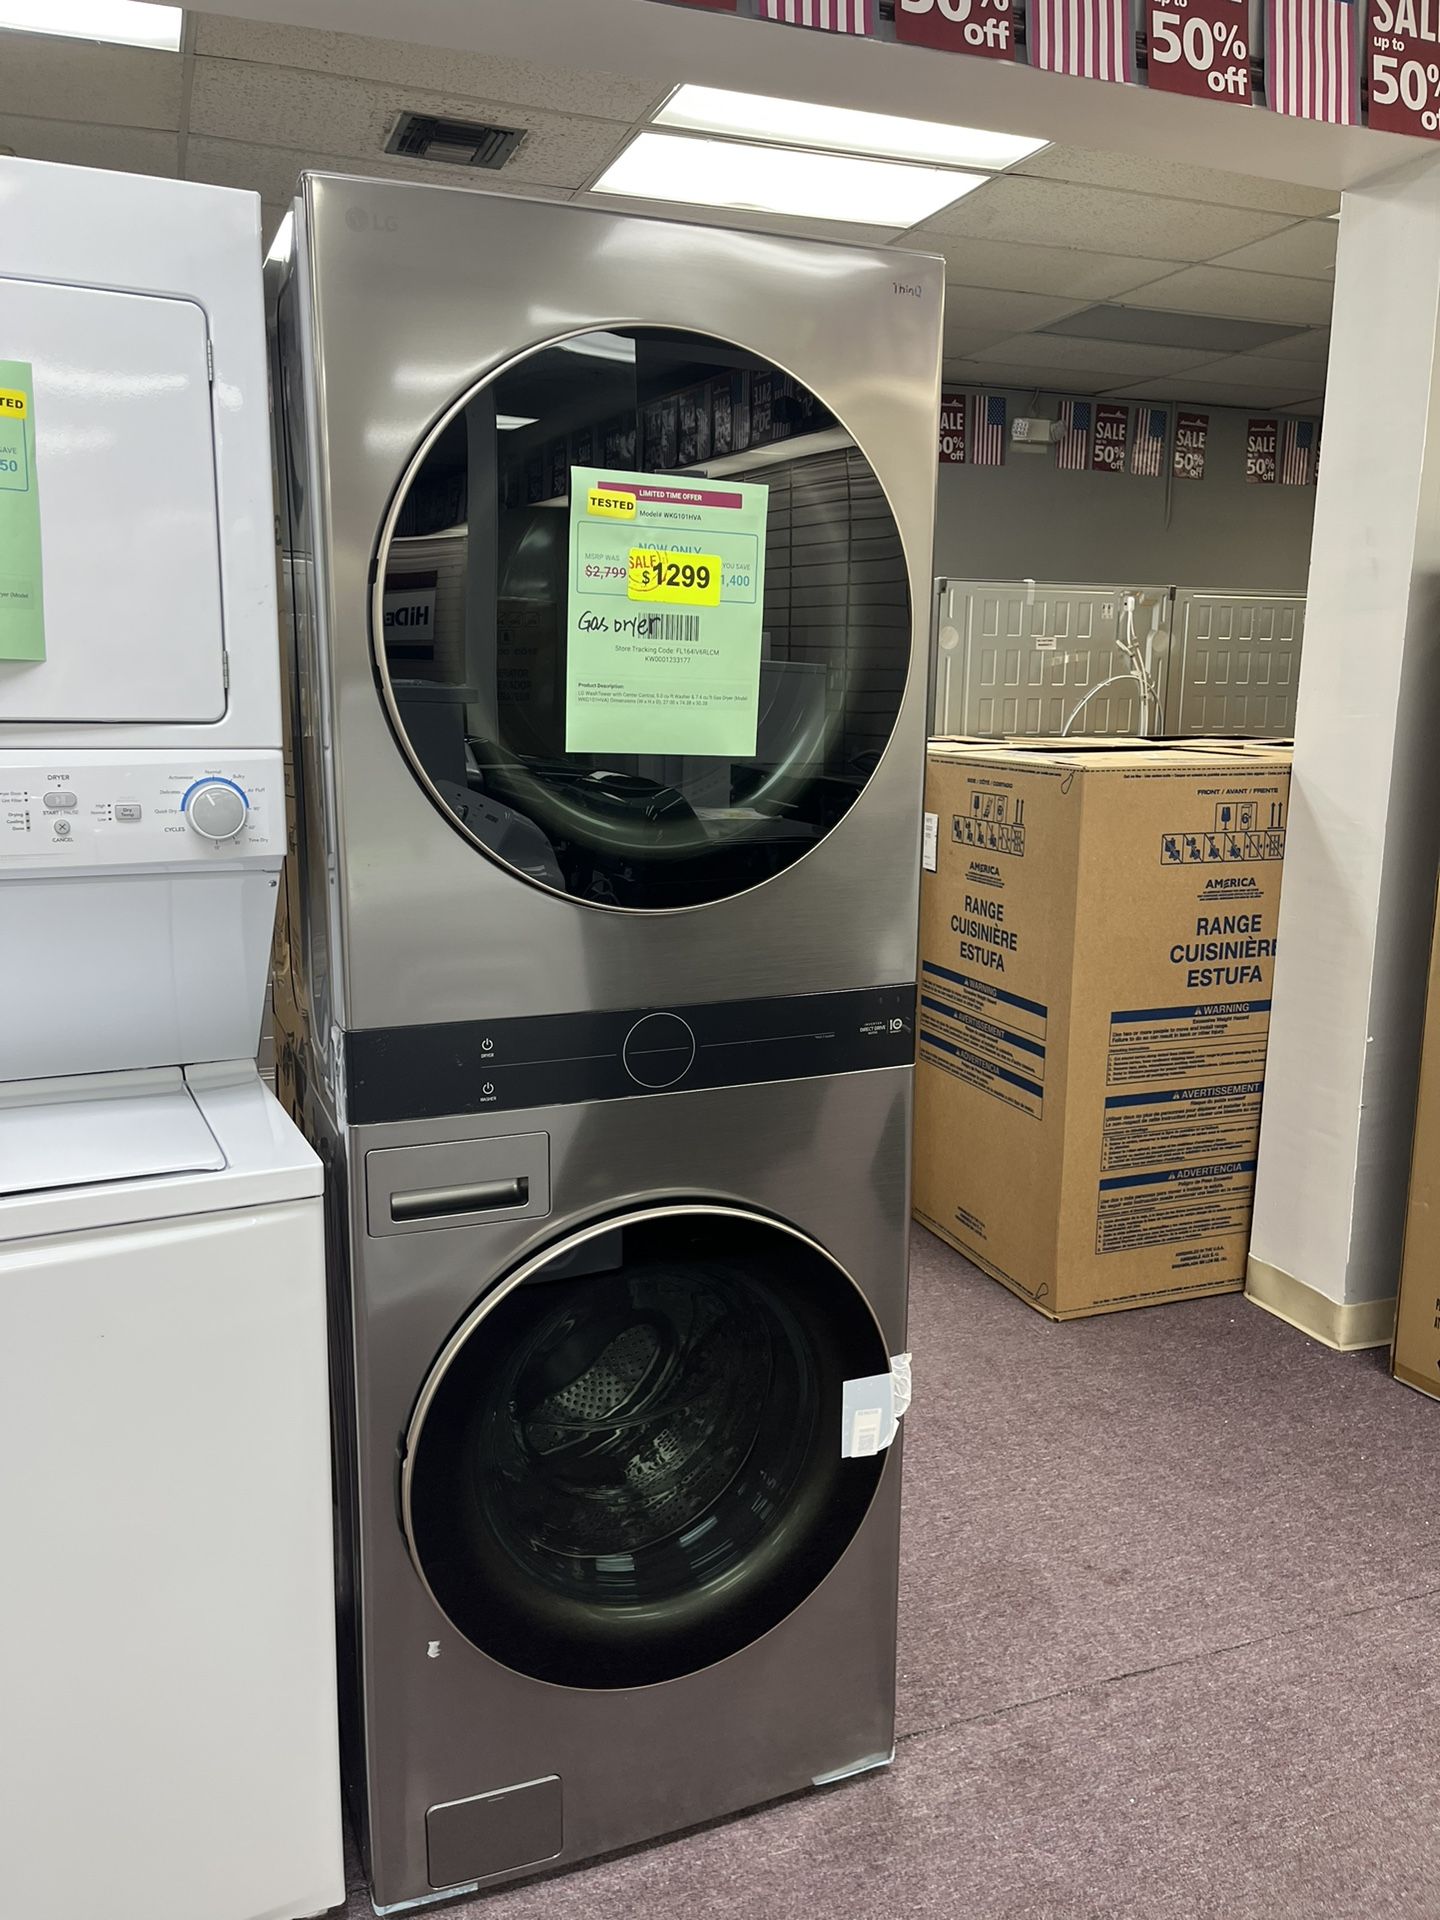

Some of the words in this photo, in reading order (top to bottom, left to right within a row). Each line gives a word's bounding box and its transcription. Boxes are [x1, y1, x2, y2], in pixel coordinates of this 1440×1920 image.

[1372, 0, 1440, 42] SAL
[964, 18, 1009, 49] off
[1152, 10, 1247, 71] 50%
[1373, 36, 1389, 50] up
[1392, 38, 1405, 52] to
[1207, 66, 1247, 95] off
[940, 412, 964, 430] ALE
[1095, 421, 1126, 441] SALE
[1176, 429, 1206, 448] SALE
[1247, 436, 1276, 453] SALE
[950, 450, 964, 460] off
[1093, 445, 1125, 463] 50%
[1174, 452, 1204, 470] 50%
[1246, 458, 1275, 475] 50%
[639, 489, 665, 498] LIMITED
[666, 491, 681, 500] TIME
[682, 493, 703, 501] OFFER
[590, 497, 634, 511] TESTED
[639, 510, 662, 518] Model#
[664, 512, 702, 521] WKG101HVA
[585, 564, 627, 579] $2,799
[578, 610, 609, 633] Gas
[632, 646, 657, 654] Tracking
[969, 861, 1000, 876] AMERICA
[1205, 877, 1256, 889] AMERICA
[965, 895, 1004, 922] RANGE
[951, 915, 1018, 951] CUISINIÈRE
[1196, 914, 1262, 936] RANGE
[960, 941, 1005, 972] ESTUFA
[1187, 965, 1262, 988] ESTUFA
[969, 980, 997, 997] WARNING
[1204, 1003, 1250, 1015] WARNING
[1182, 1083, 1260, 1099] AVERTISSEMENT
[1177, 1163, 1242, 1178] ADVERTENCIA
